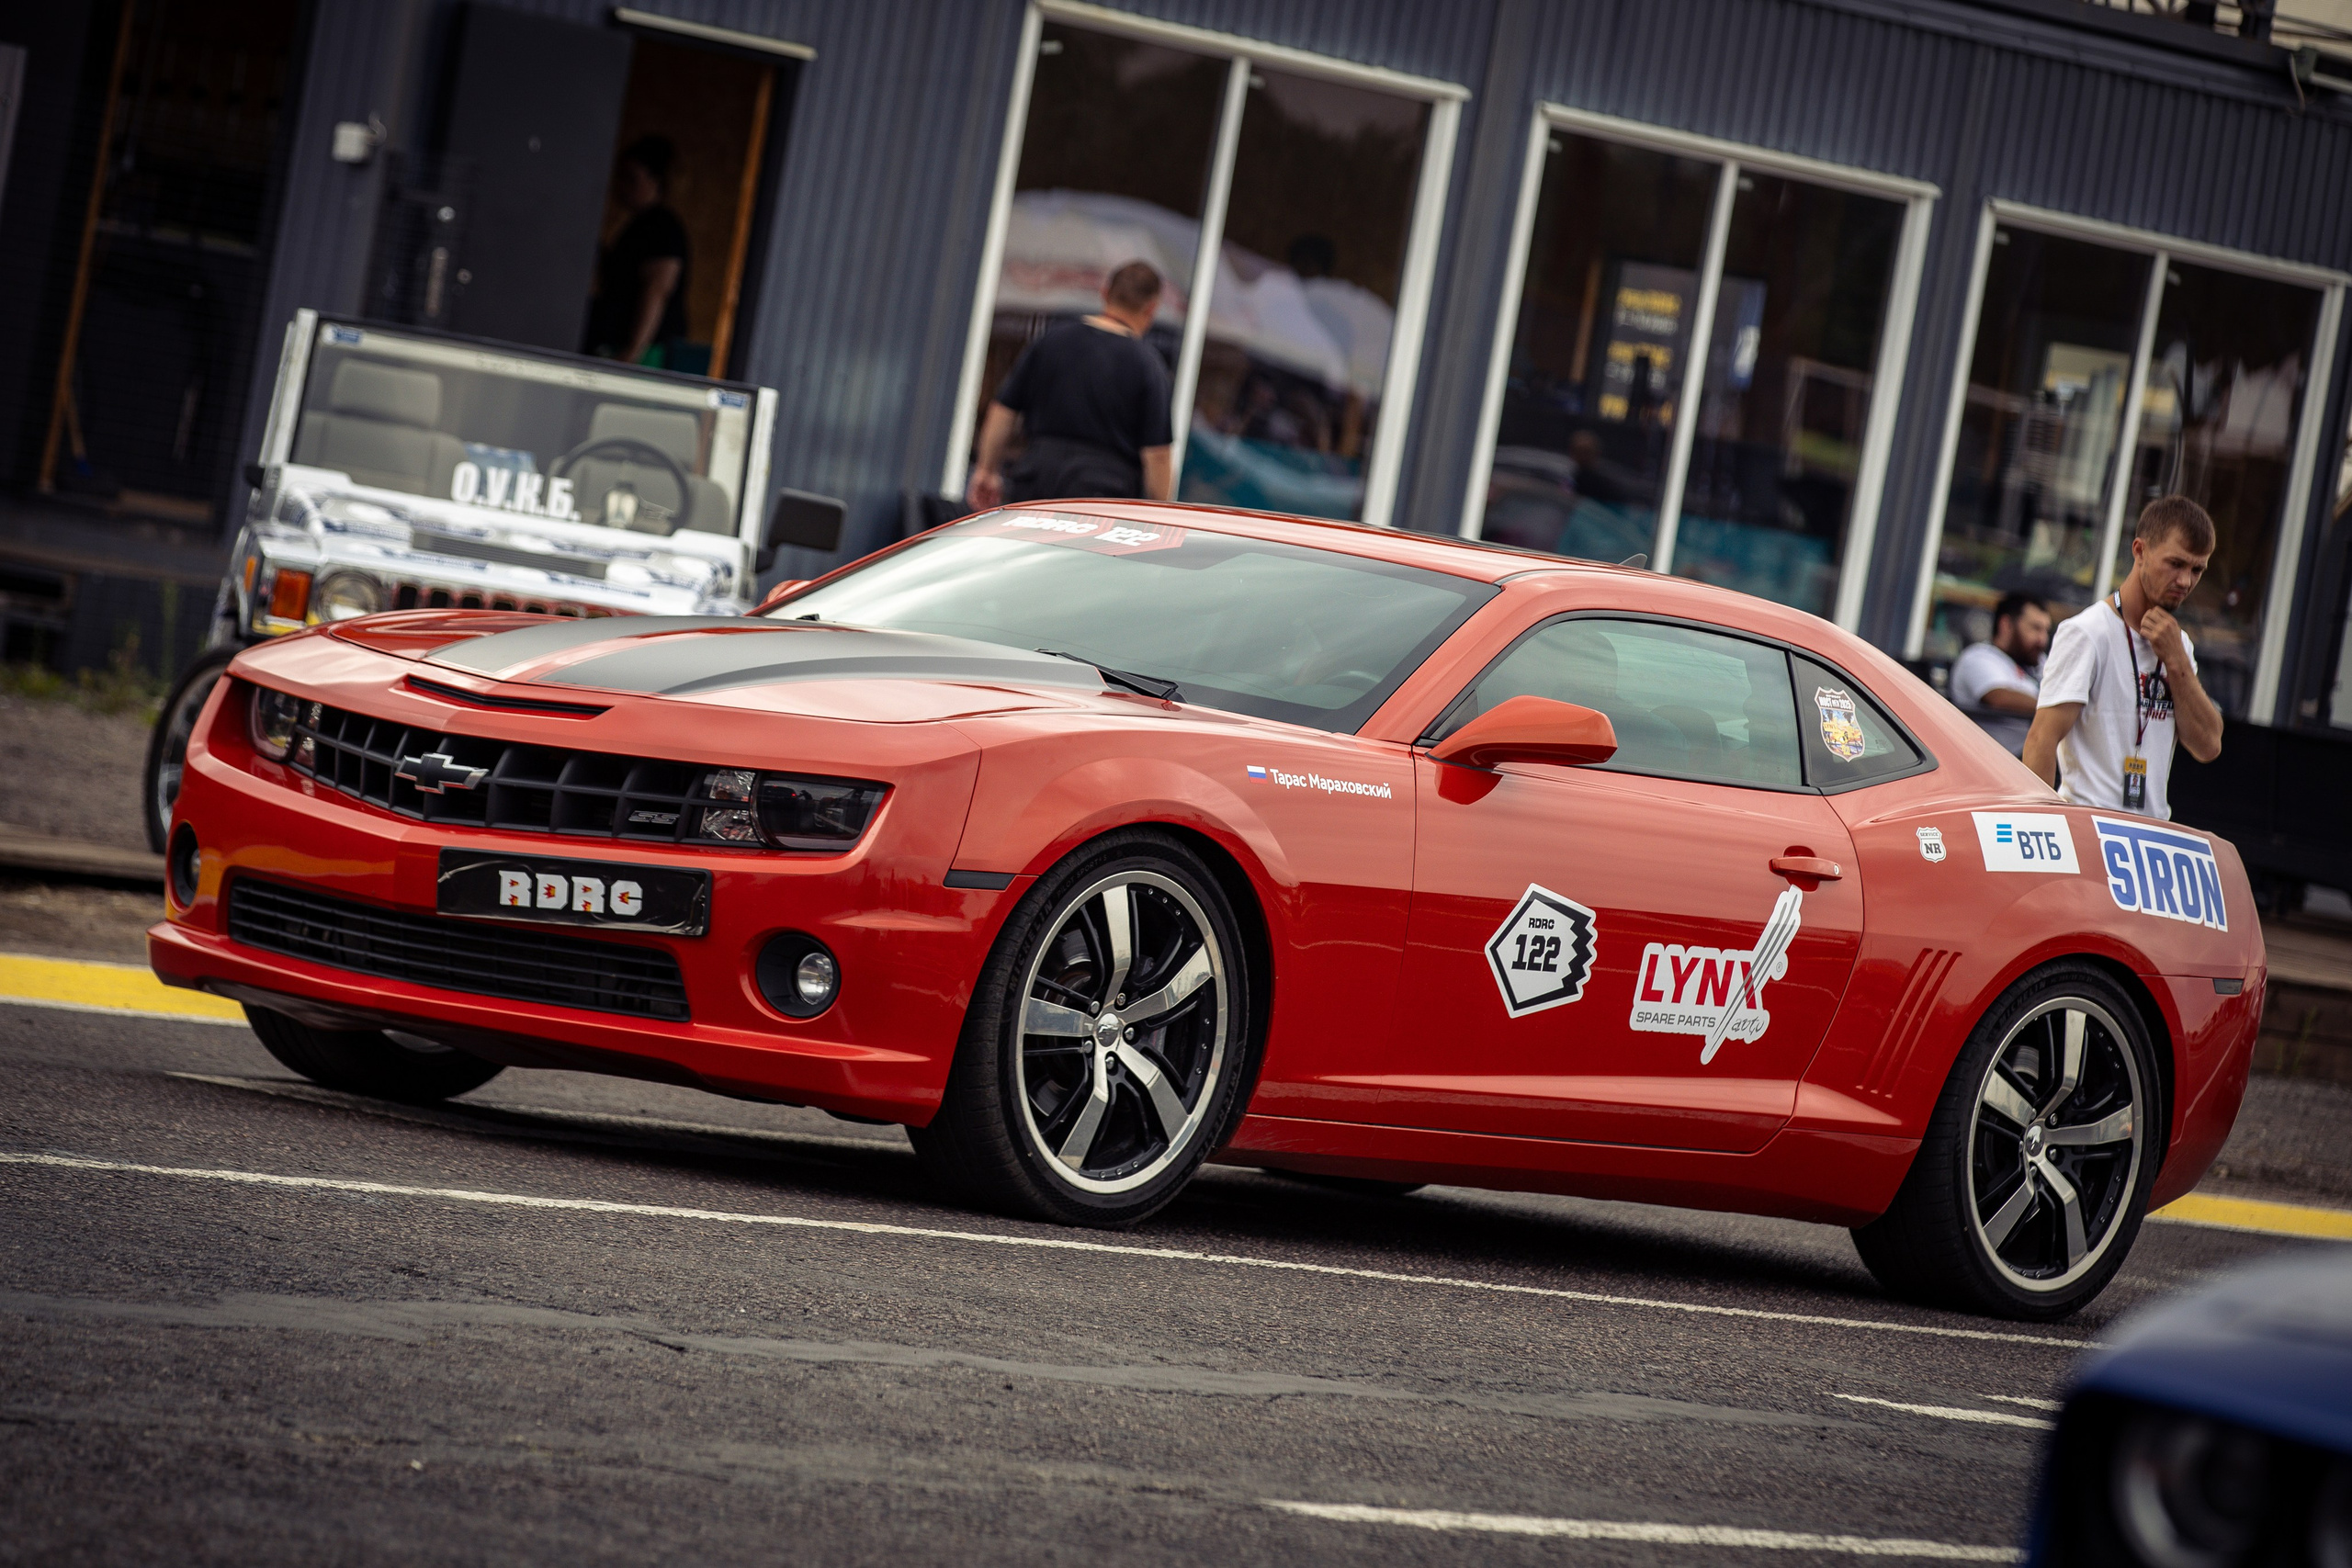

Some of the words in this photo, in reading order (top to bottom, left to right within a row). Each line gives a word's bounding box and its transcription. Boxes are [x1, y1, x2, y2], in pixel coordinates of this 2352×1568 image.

[1001, 516, 1098, 534] RDRC
[1094, 526, 1160, 547] 122
[1270, 768, 1307, 789] Тарас
[1308, 773, 1392, 799] Мараховский
[628, 810, 680, 825] SS
[1924, 842, 1942, 854] NR
[2017, 830, 2062, 861] ВТБ
[2097, 821, 2226, 927] STRON
[499, 870, 642, 917] RDRC
[1008, 899, 1054, 993] MICHELIN
[1076, 861, 1099, 878] SPORT
[1528, 918, 1555, 930] RDRC
[1511, 934, 1561, 972] 122
[1640, 953, 1758, 1010] LYNX
[1636, 1011, 1676, 1025] SPARE
[1678, 1014, 1716, 1027] PARTS
[1731, 1016, 1765, 1035] auto
